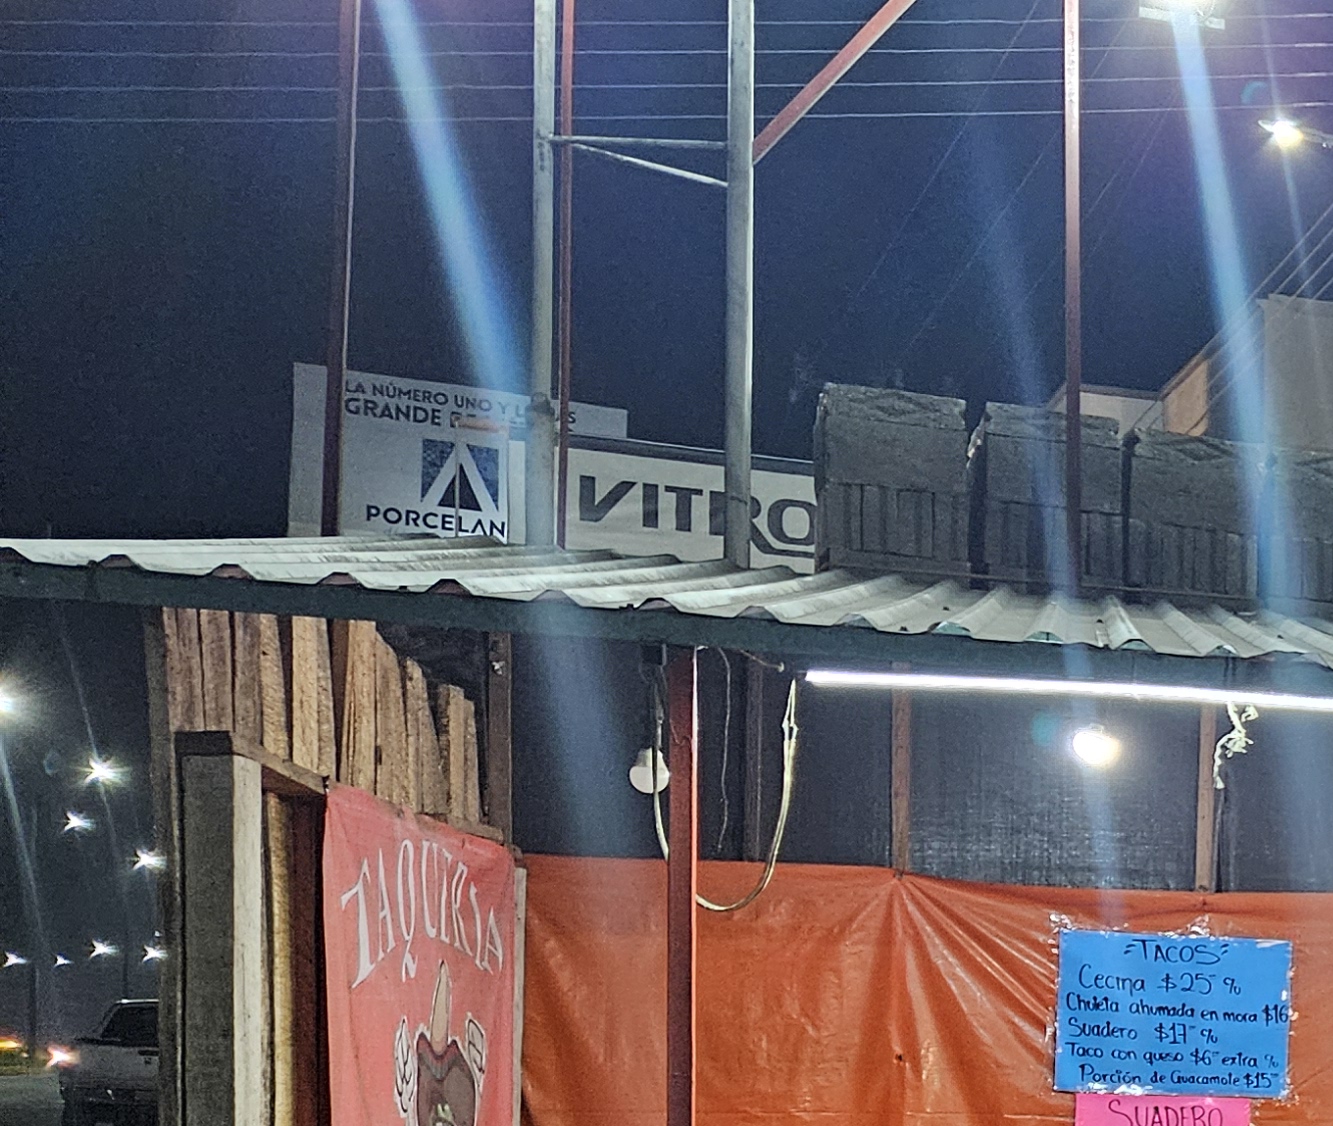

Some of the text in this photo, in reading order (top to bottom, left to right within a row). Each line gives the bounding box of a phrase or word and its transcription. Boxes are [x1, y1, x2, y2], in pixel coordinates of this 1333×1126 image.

[372, 382, 448, 406] NÚMERO
[454, 394, 492, 412] UNO
[345, 397, 441, 426] GRANDE
[1133, 939, 1221, 965] TACOS
[1079, 964, 1146, 995] Cecina
[1066, 992, 1119, 1012] Chuleta
[1129, 999, 1195, 1018] ahumada
[1201, 1009, 1219, 1022] en
[1068, 1016, 1138, 1040] Suadero
[1065, 1042, 1104, 1059] Taco
[1110, 1049, 1137, 1061] con
[1143, 1051, 1184, 1067] queso
[1221, 1051, 1258, 1069] extra
[1150, 1070, 1167, 1085] de
[1170, 1070, 1240, 1087] Guacamole
